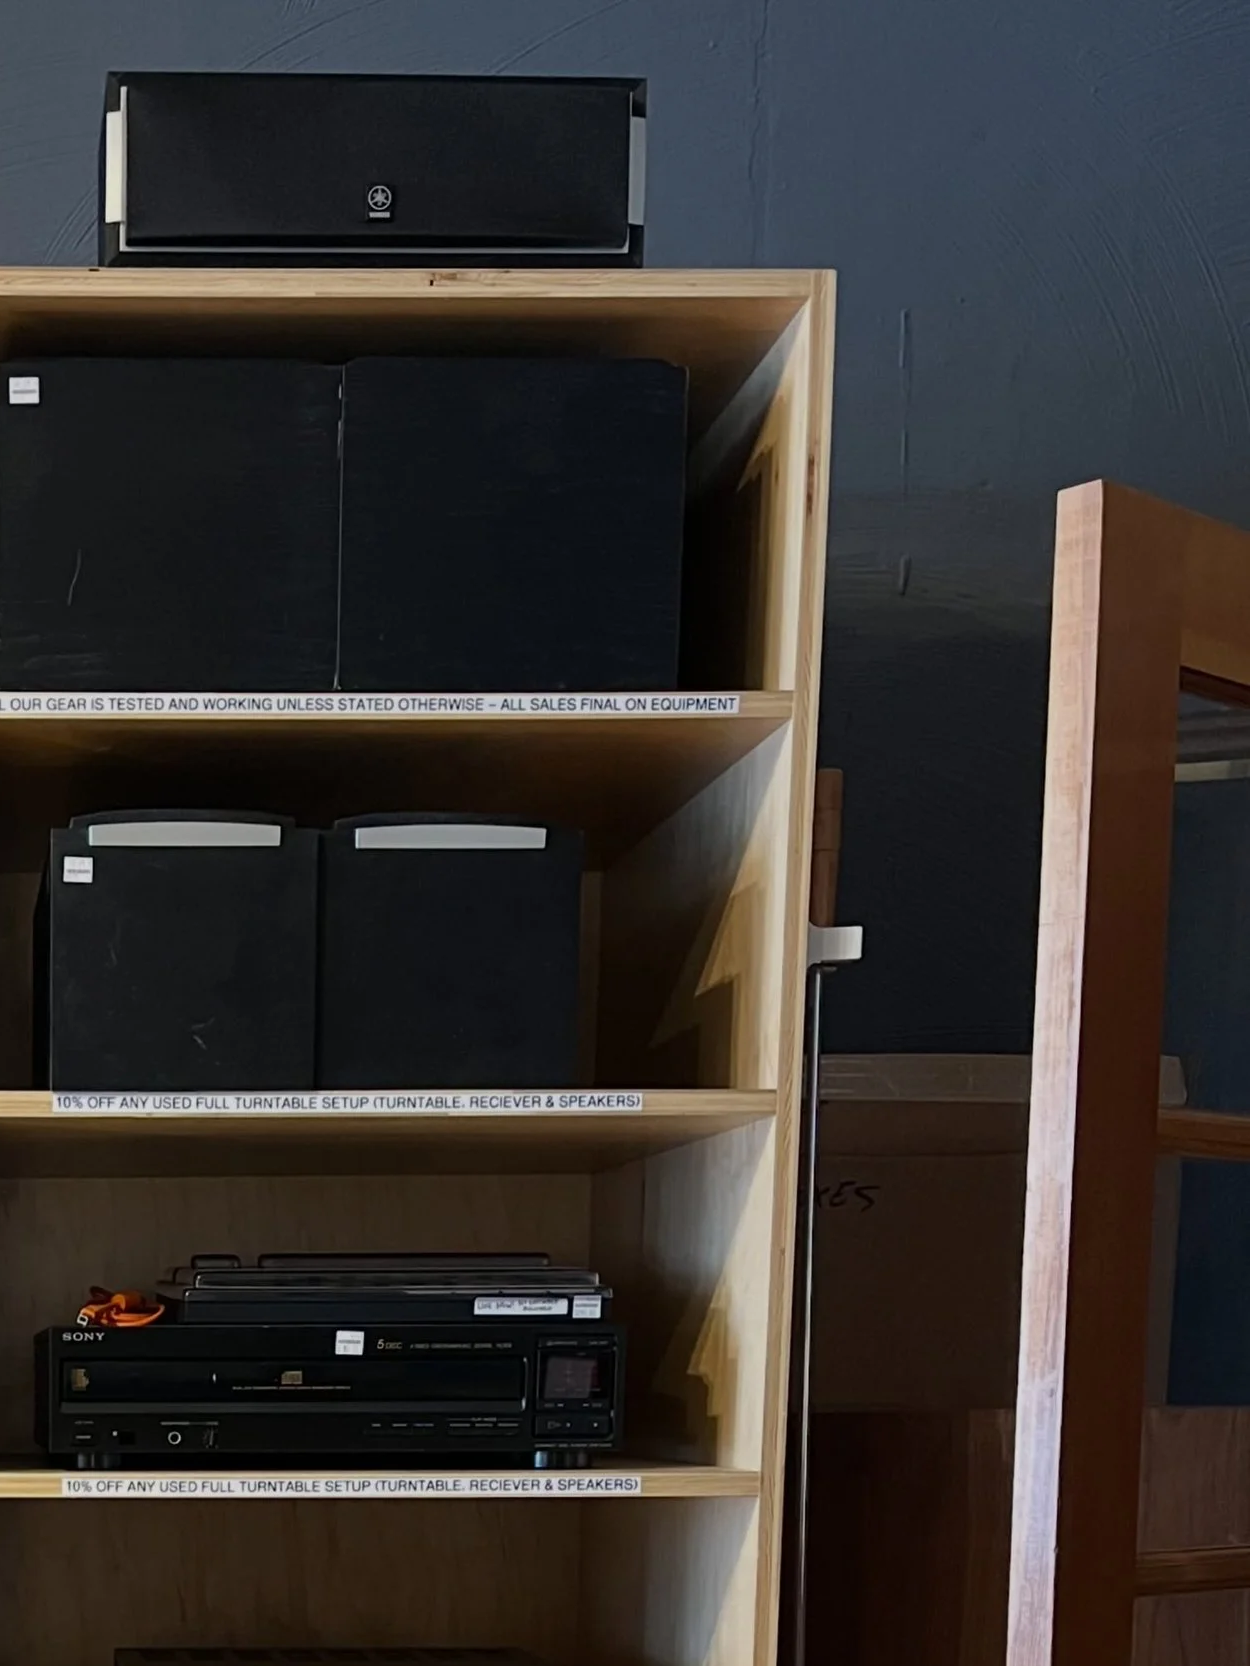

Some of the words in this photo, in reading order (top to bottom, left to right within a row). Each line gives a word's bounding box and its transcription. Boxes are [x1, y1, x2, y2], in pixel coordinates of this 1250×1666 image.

[10, 698, 42, 712] OUR
[46, 698, 87, 712] GEAR
[91, 698, 105, 712] IS
[108, 698, 165, 712] TESTED
[168, 698, 199, 712] AND
[203, 698, 273, 712] WORKING
[276, 698, 334, 712] UNLESS
[338, 698, 394, 712] STATED
[398, 698, 484, 712] OTHERWISE
[500, 698, 526, 712] ALL
[530, 698, 577, 712] SALES
[580, 698, 621, 712] FINAL
[624, 698, 647, 712] ON
[651, 698, 737, 712] EQUIPMENT
[57, 1096, 83, 1109] 10%
[87, 1096, 115, 1109] OFF
[119, 1096, 149, 1109] ANY
[153, 1096, 192, 1109] USED
[196, 1096, 229, 1109] FULL
[235, 1096, 317, 1109] TURNTABLE
[322, 1096, 369, 1109] SETUP
[470, 1095, 541, 1108] RECIEVER
[545, 1095, 554, 1108] &
[559, 1095, 640, 1108] SPEAKERS)
[816, 1181, 881, 1213] XES
[62, 1332, 106, 1341] SONY
[67, 1480, 92, 1493] 10%
[96, 1480, 124, 1493] OFF
[127, 1480, 156, 1492] ANY
[159, 1480, 198, 1492] USED
[201, 1480, 235, 1492] FULL
[239, 1480, 321, 1492] TURNTABLE
[324, 1480, 371, 1492] SETUP
[469, 1479, 541, 1492] RECIEVER
[544, 1479, 554, 1492] &
[557, 1479, 638, 1491] SPEAKERS)
